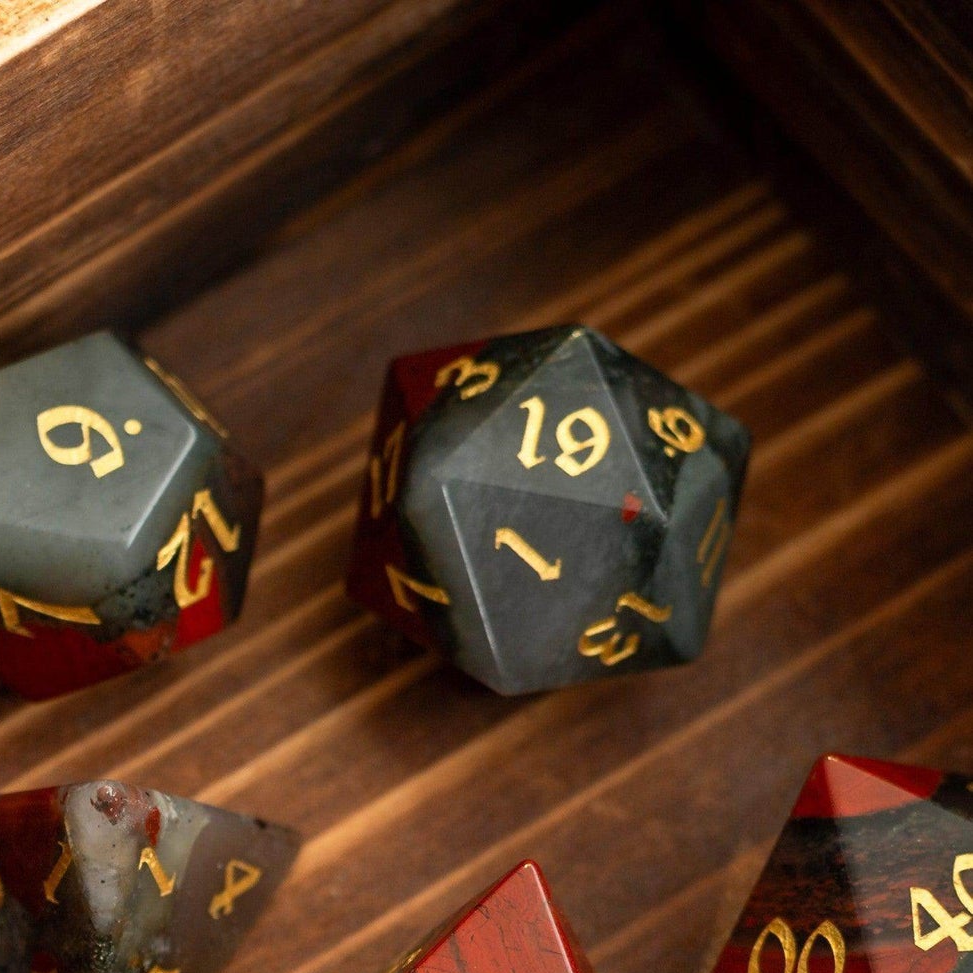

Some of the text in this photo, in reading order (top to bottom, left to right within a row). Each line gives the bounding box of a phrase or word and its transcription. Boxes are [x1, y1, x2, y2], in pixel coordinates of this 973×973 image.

[434, 355, 500, 400] 3
[517, 396, 611, 477] 19
[156, 488, 241, 610] 12
[494, 527, 562, 582] 1
[385, 564, 451, 613] 7
[578, 592, 673, 667] 13
[43, 841, 73, 904] 1
[138, 846, 177, 898] 1
[208, 858, 262, 920] 4
